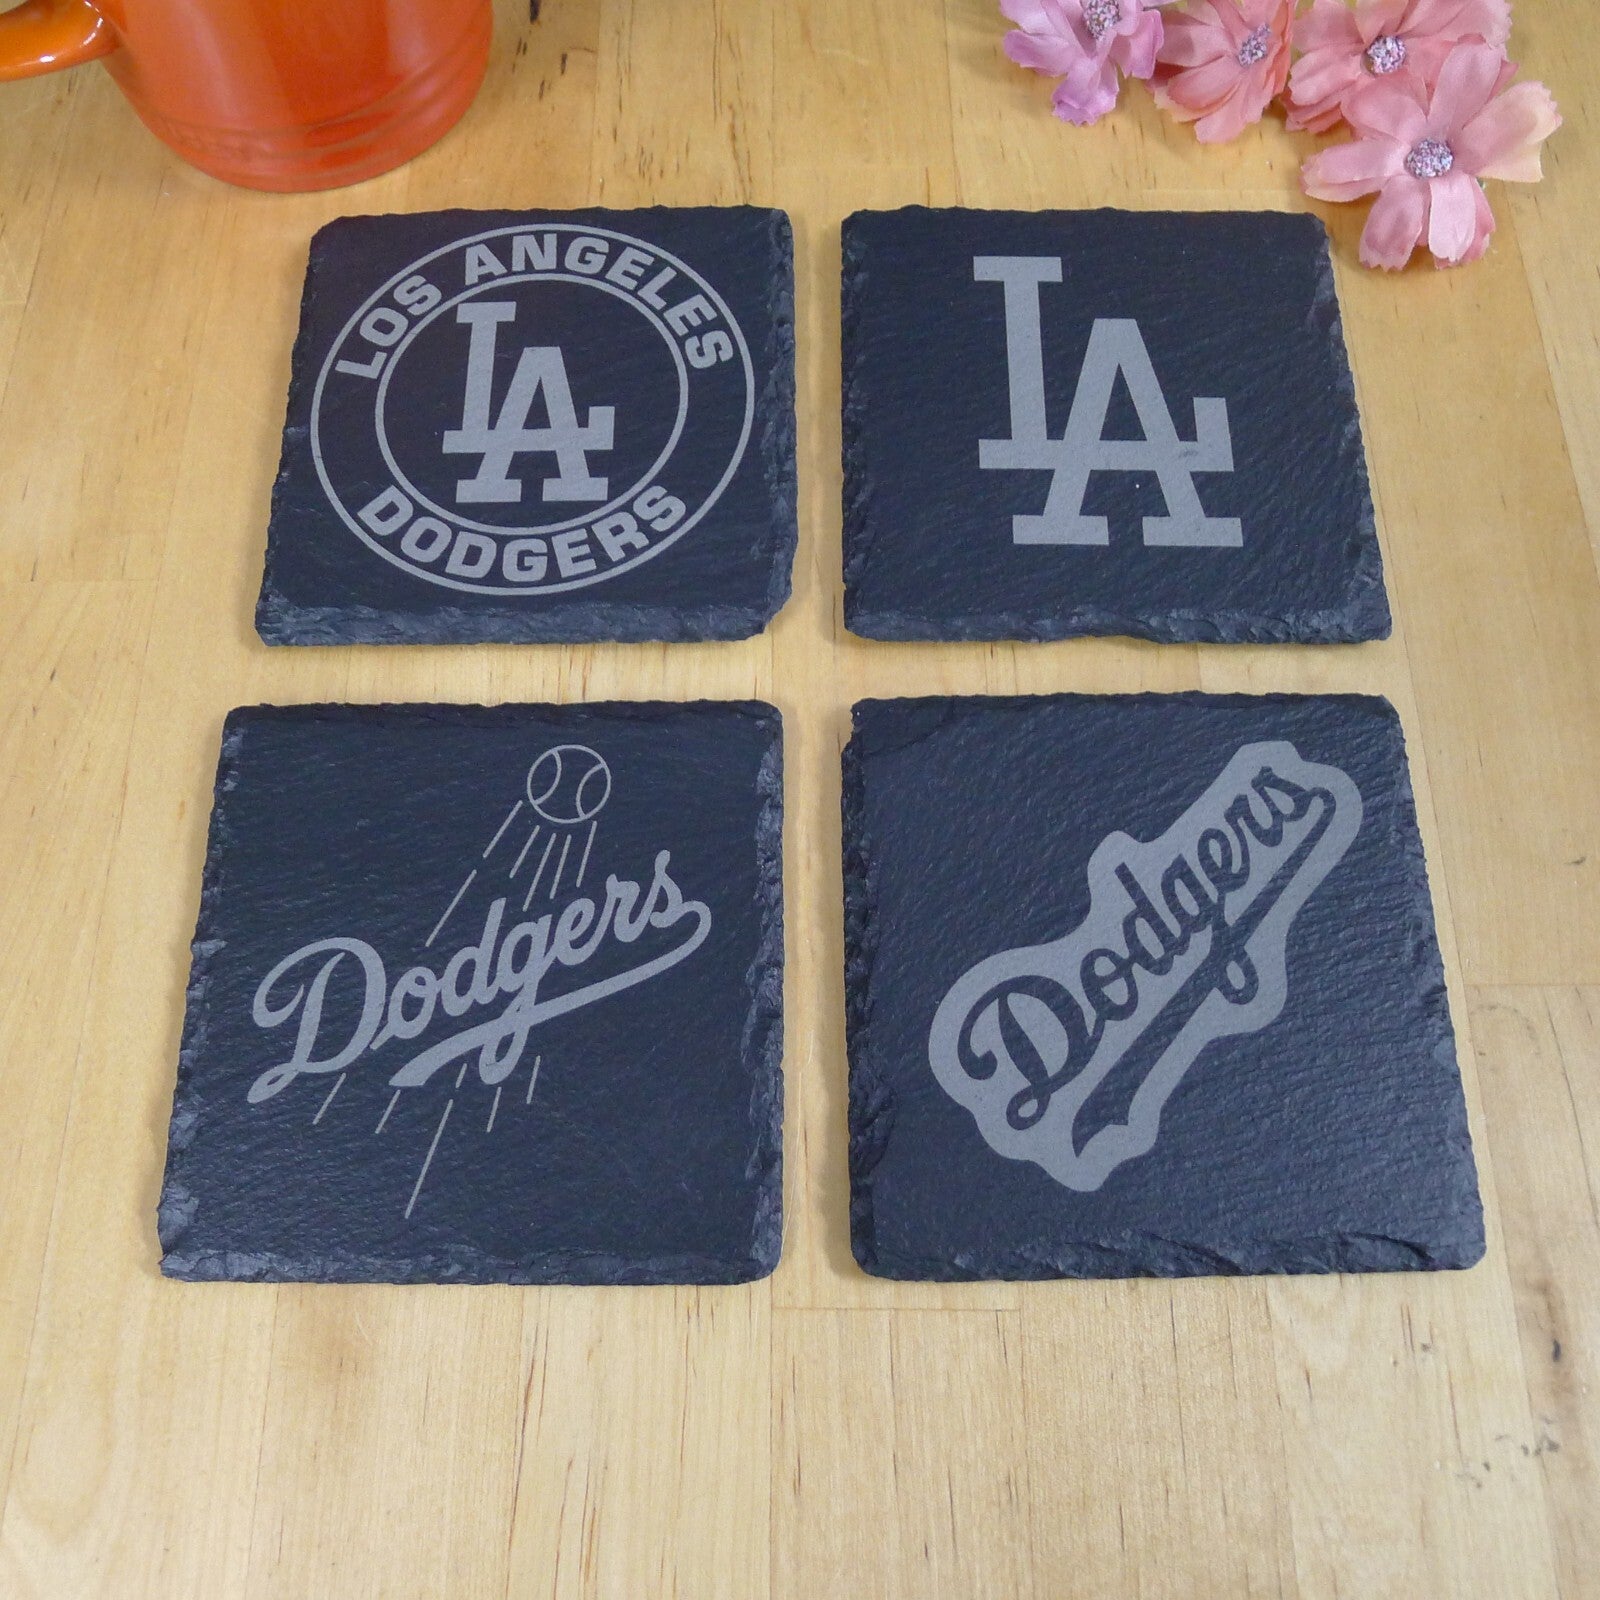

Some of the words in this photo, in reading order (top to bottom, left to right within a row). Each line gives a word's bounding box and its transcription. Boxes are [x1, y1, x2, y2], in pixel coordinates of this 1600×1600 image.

[335, 273, 442, 380] LOS
[464, 233, 733, 370] ANGELES
[442, 301, 616, 503] LA
[972, 255, 1244, 548] LA
[356, 485, 687, 582] DODGERS
[246, 849, 712, 1104] Dodgers
[956, 765, 1337, 1158] Dodgers
